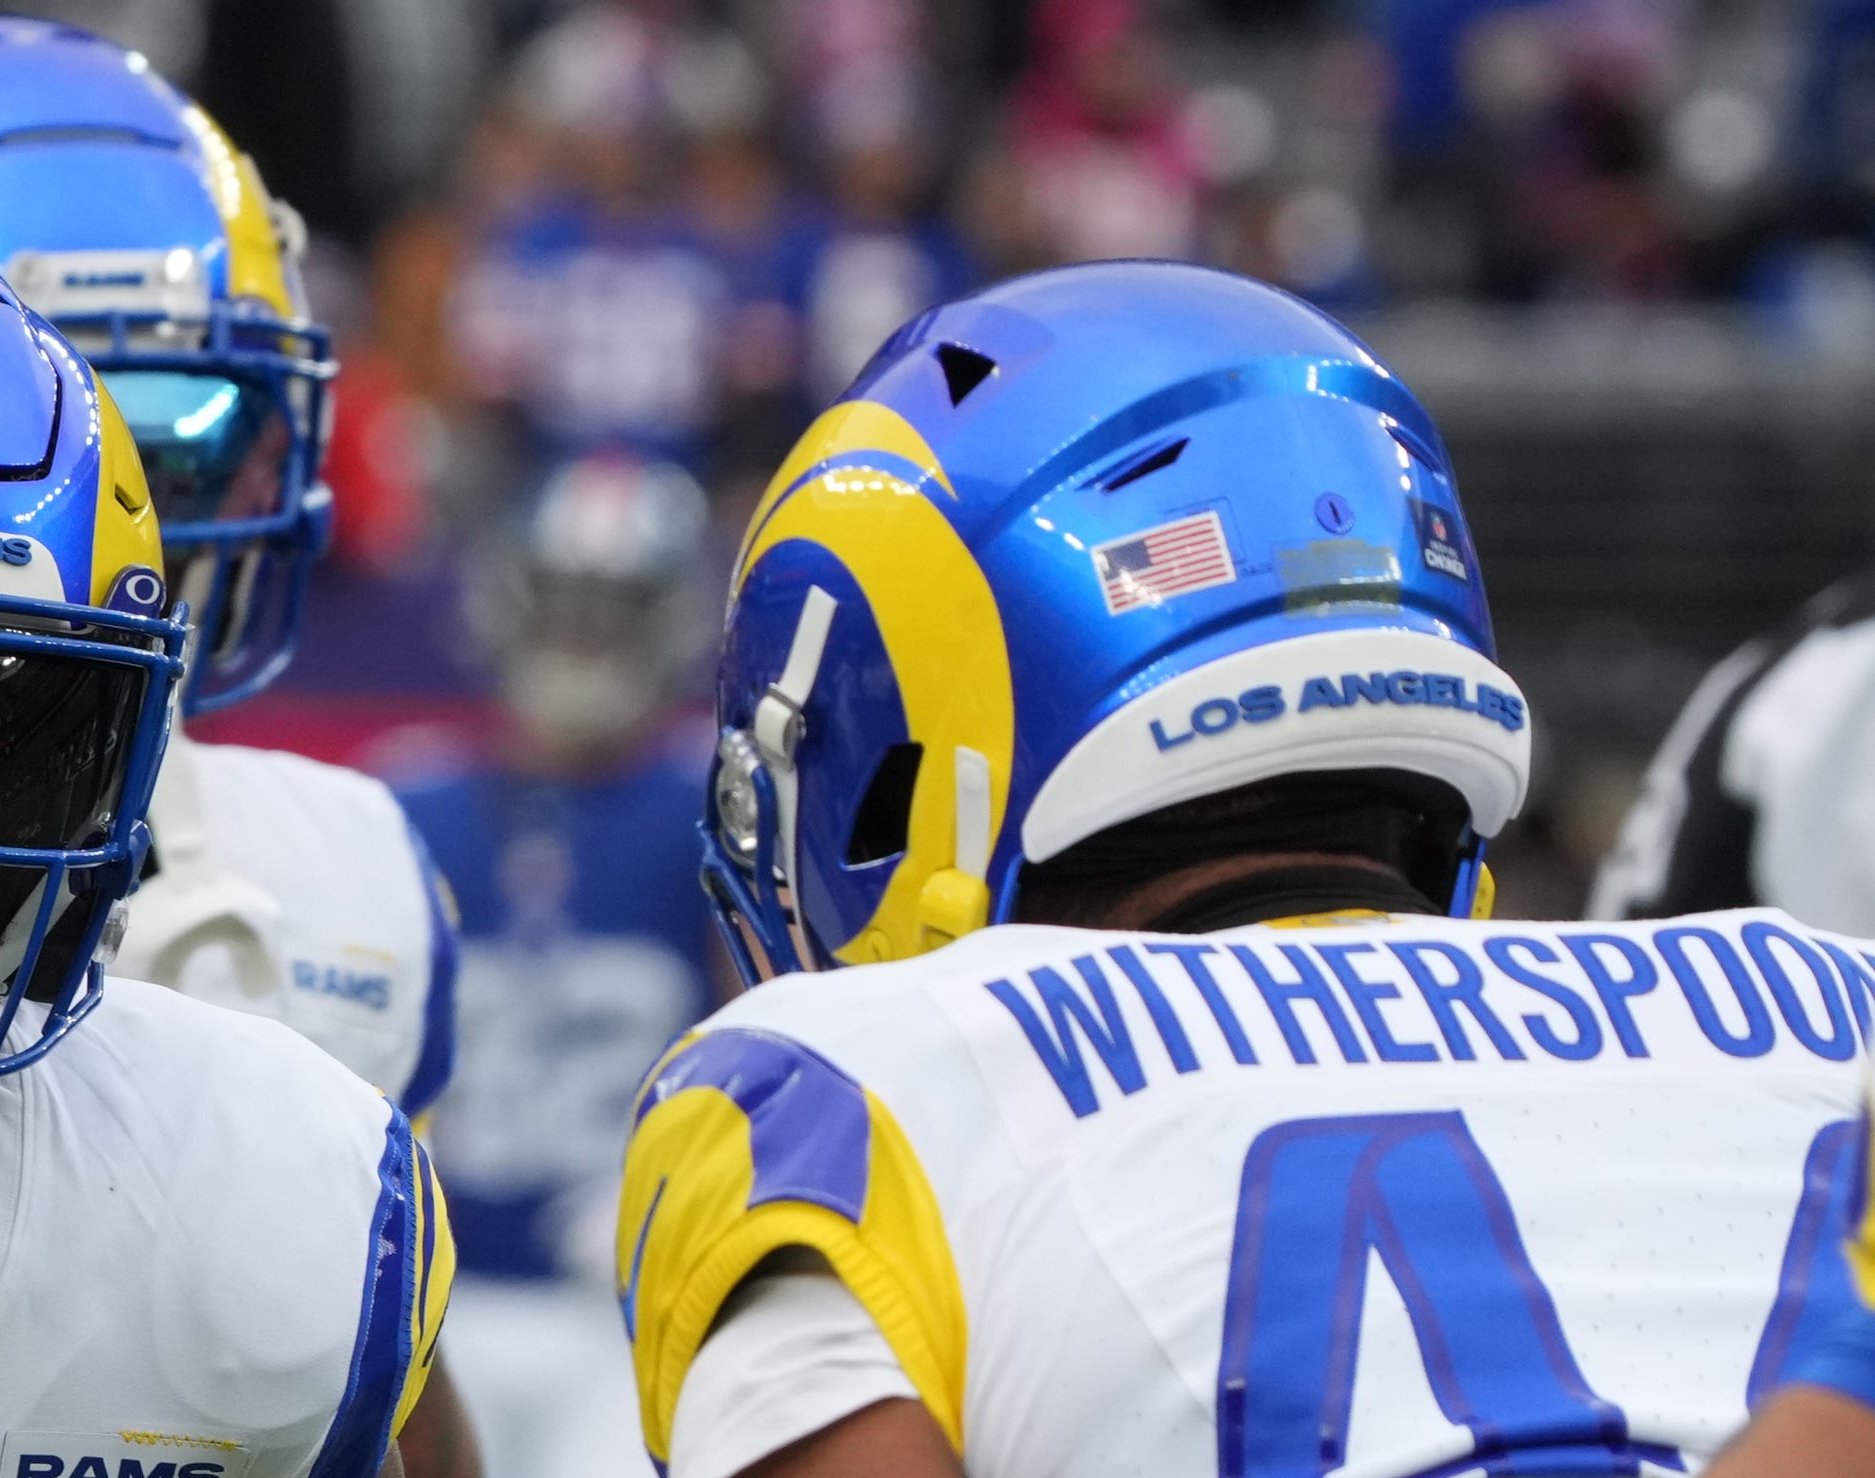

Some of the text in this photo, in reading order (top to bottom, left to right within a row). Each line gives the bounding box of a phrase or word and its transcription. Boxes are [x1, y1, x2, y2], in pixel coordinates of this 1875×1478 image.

[1148, 671, 1525, 753] LOS ANGELES
[291, 958, 392, 1011] RAMS
